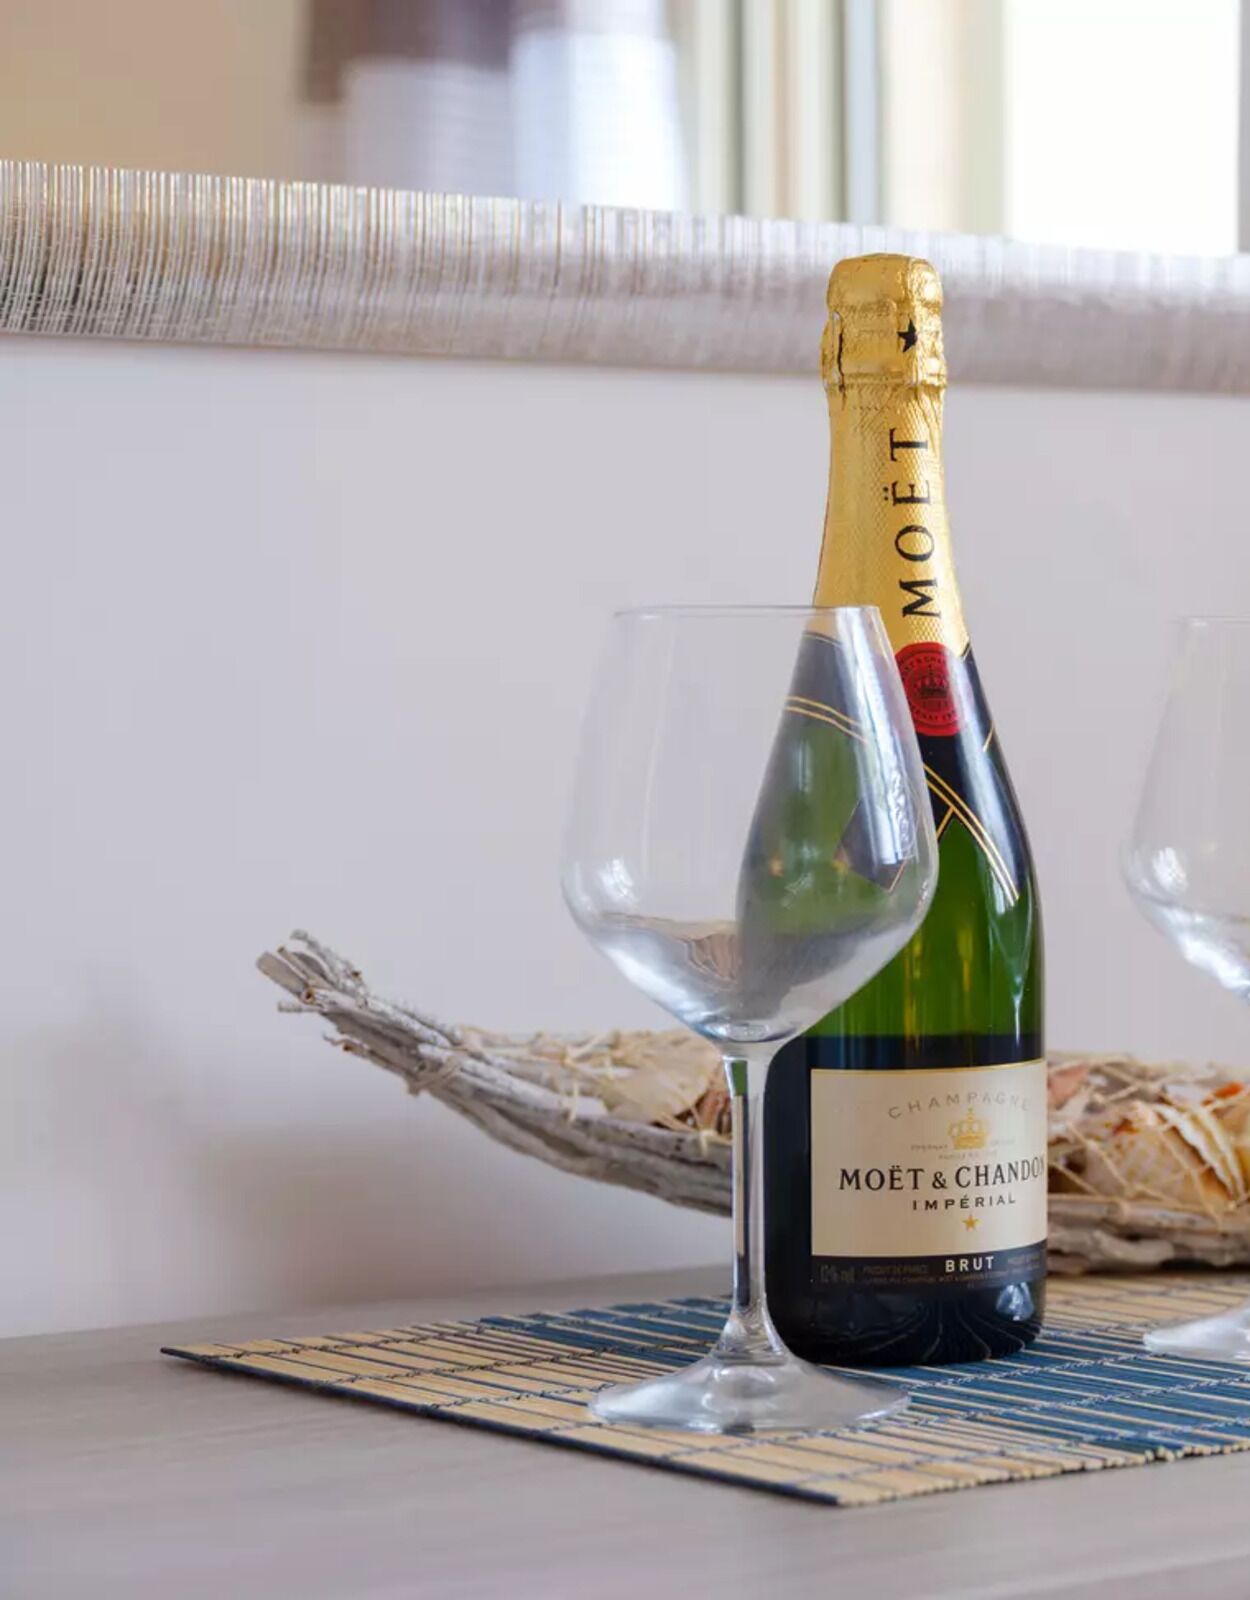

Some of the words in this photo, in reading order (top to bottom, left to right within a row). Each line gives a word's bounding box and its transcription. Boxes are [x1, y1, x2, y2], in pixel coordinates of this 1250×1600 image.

[883, 427, 941, 618] MOËT
[888, 1091, 1030, 1120] CHAMPAGNE
[839, 1165, 925, 1191] MOËT
[931, 1171, 948, 1189] &
[912, 1193, 1016, 1211] IMPÉRIAL
[945, 1256, 994, 1273] BRUT
